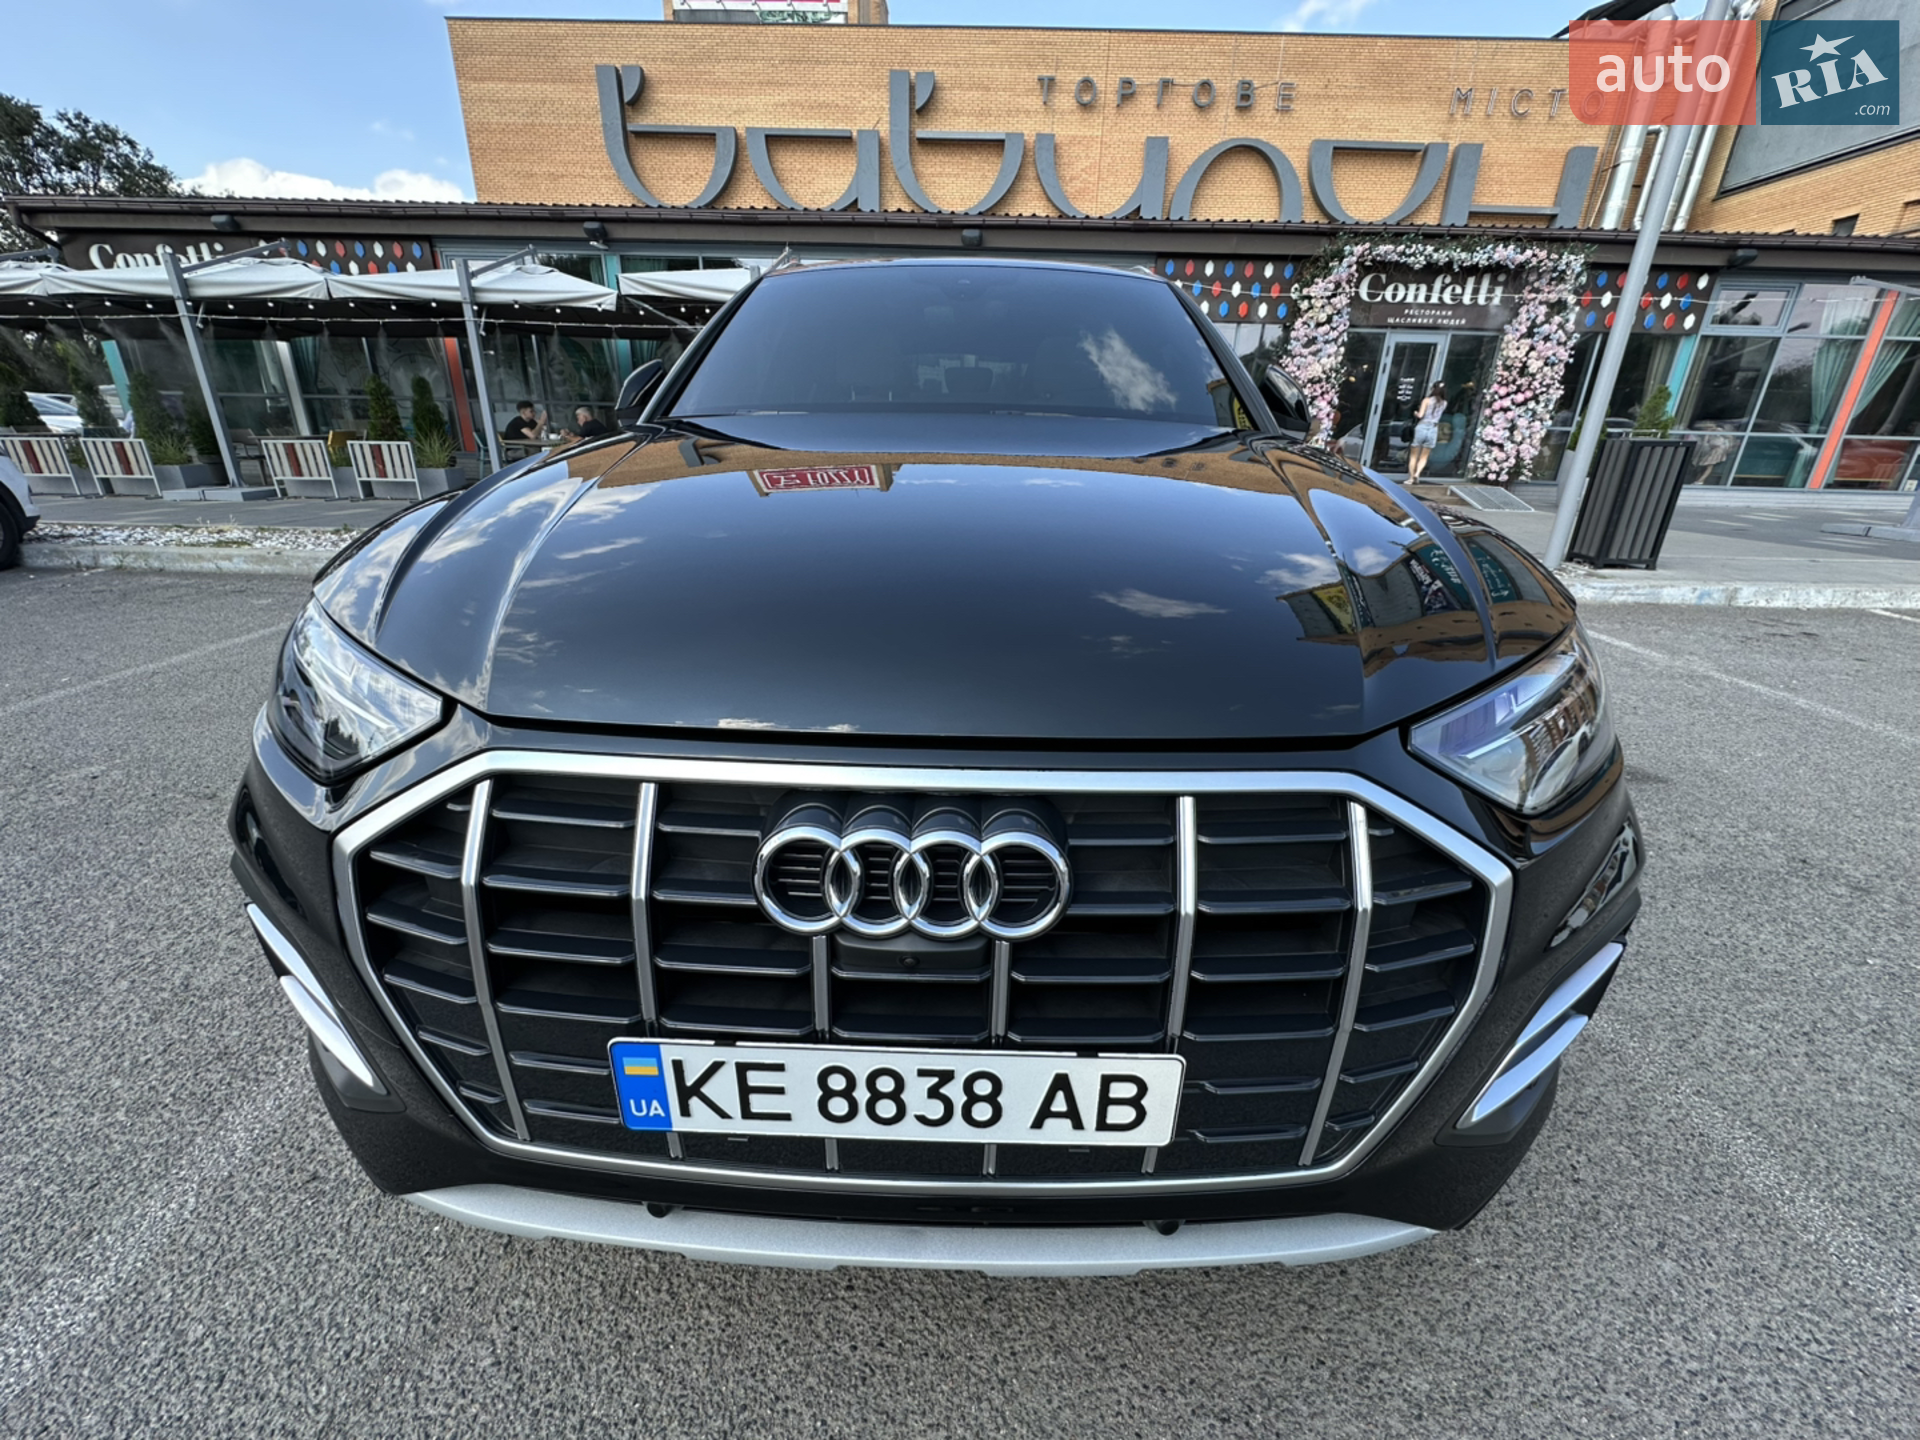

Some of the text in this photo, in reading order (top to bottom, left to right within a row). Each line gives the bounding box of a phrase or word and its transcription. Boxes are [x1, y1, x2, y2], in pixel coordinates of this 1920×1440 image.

[1037, 74, 1298, 110] ТОРГОВЕ
[1358, 272, 1507, 305] Confetti
[631, 1099, 665, 1118] UA
[671, 1058, 1148, 1133] KE 8838 AB
